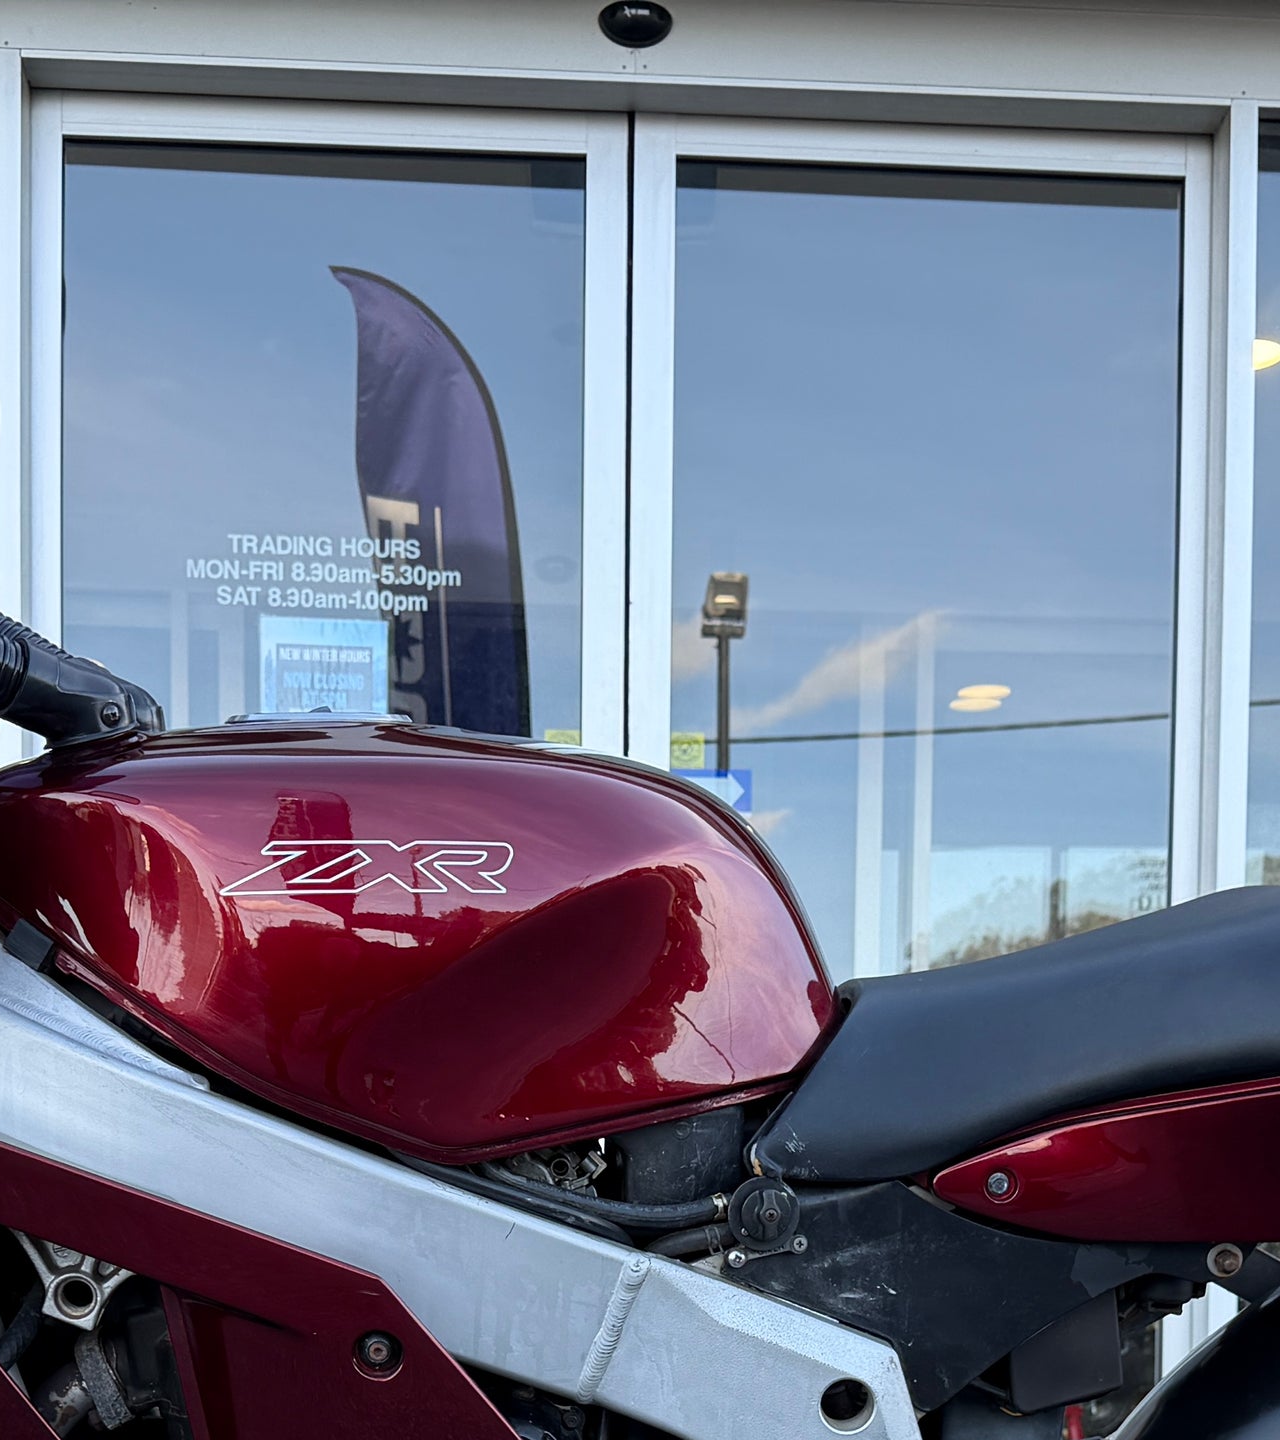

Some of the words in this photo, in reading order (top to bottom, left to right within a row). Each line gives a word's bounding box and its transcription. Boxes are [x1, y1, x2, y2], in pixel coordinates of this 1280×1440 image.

[228, 534, 332, 556] TRADING
[341, 538, 421, 560] HOURS
[186, 559, 284, 581] MON-FRI
[291, 562, 462, 591] 8.30am-5.30pm
[216, 585, 261, 606] SAT
[268, 587, 428, 615] 8.30am-1.00pm
[280, 647, 300, 661] NEW
[220, 840, 514, 896] ZXR
